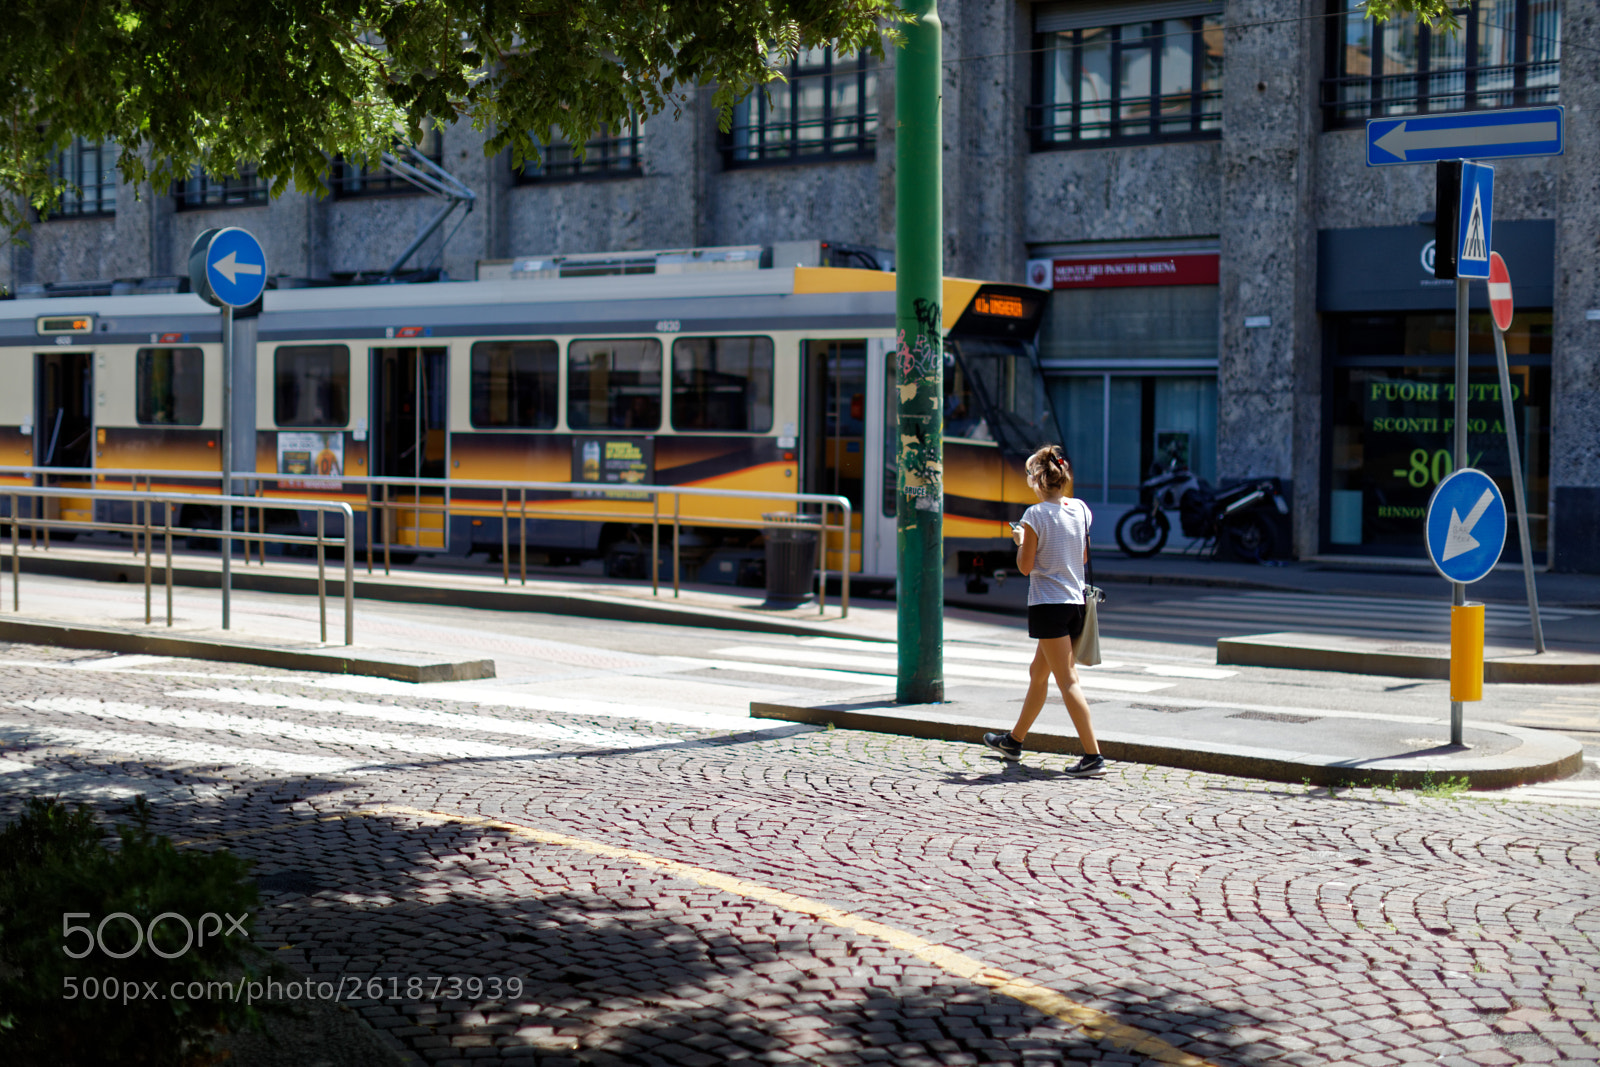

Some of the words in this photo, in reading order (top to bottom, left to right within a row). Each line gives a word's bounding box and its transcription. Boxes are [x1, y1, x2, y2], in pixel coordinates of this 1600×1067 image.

[1371, 383, 1438, 401] FUORI
[1373, 417, 1438, 433] SCONTI
[1444, 418, 1487, 433] FNO
[1491, 419, 1506, 434] A
[1393, 449, 1484, 487] -80
[905, 486, 926, 496] BRUCE
